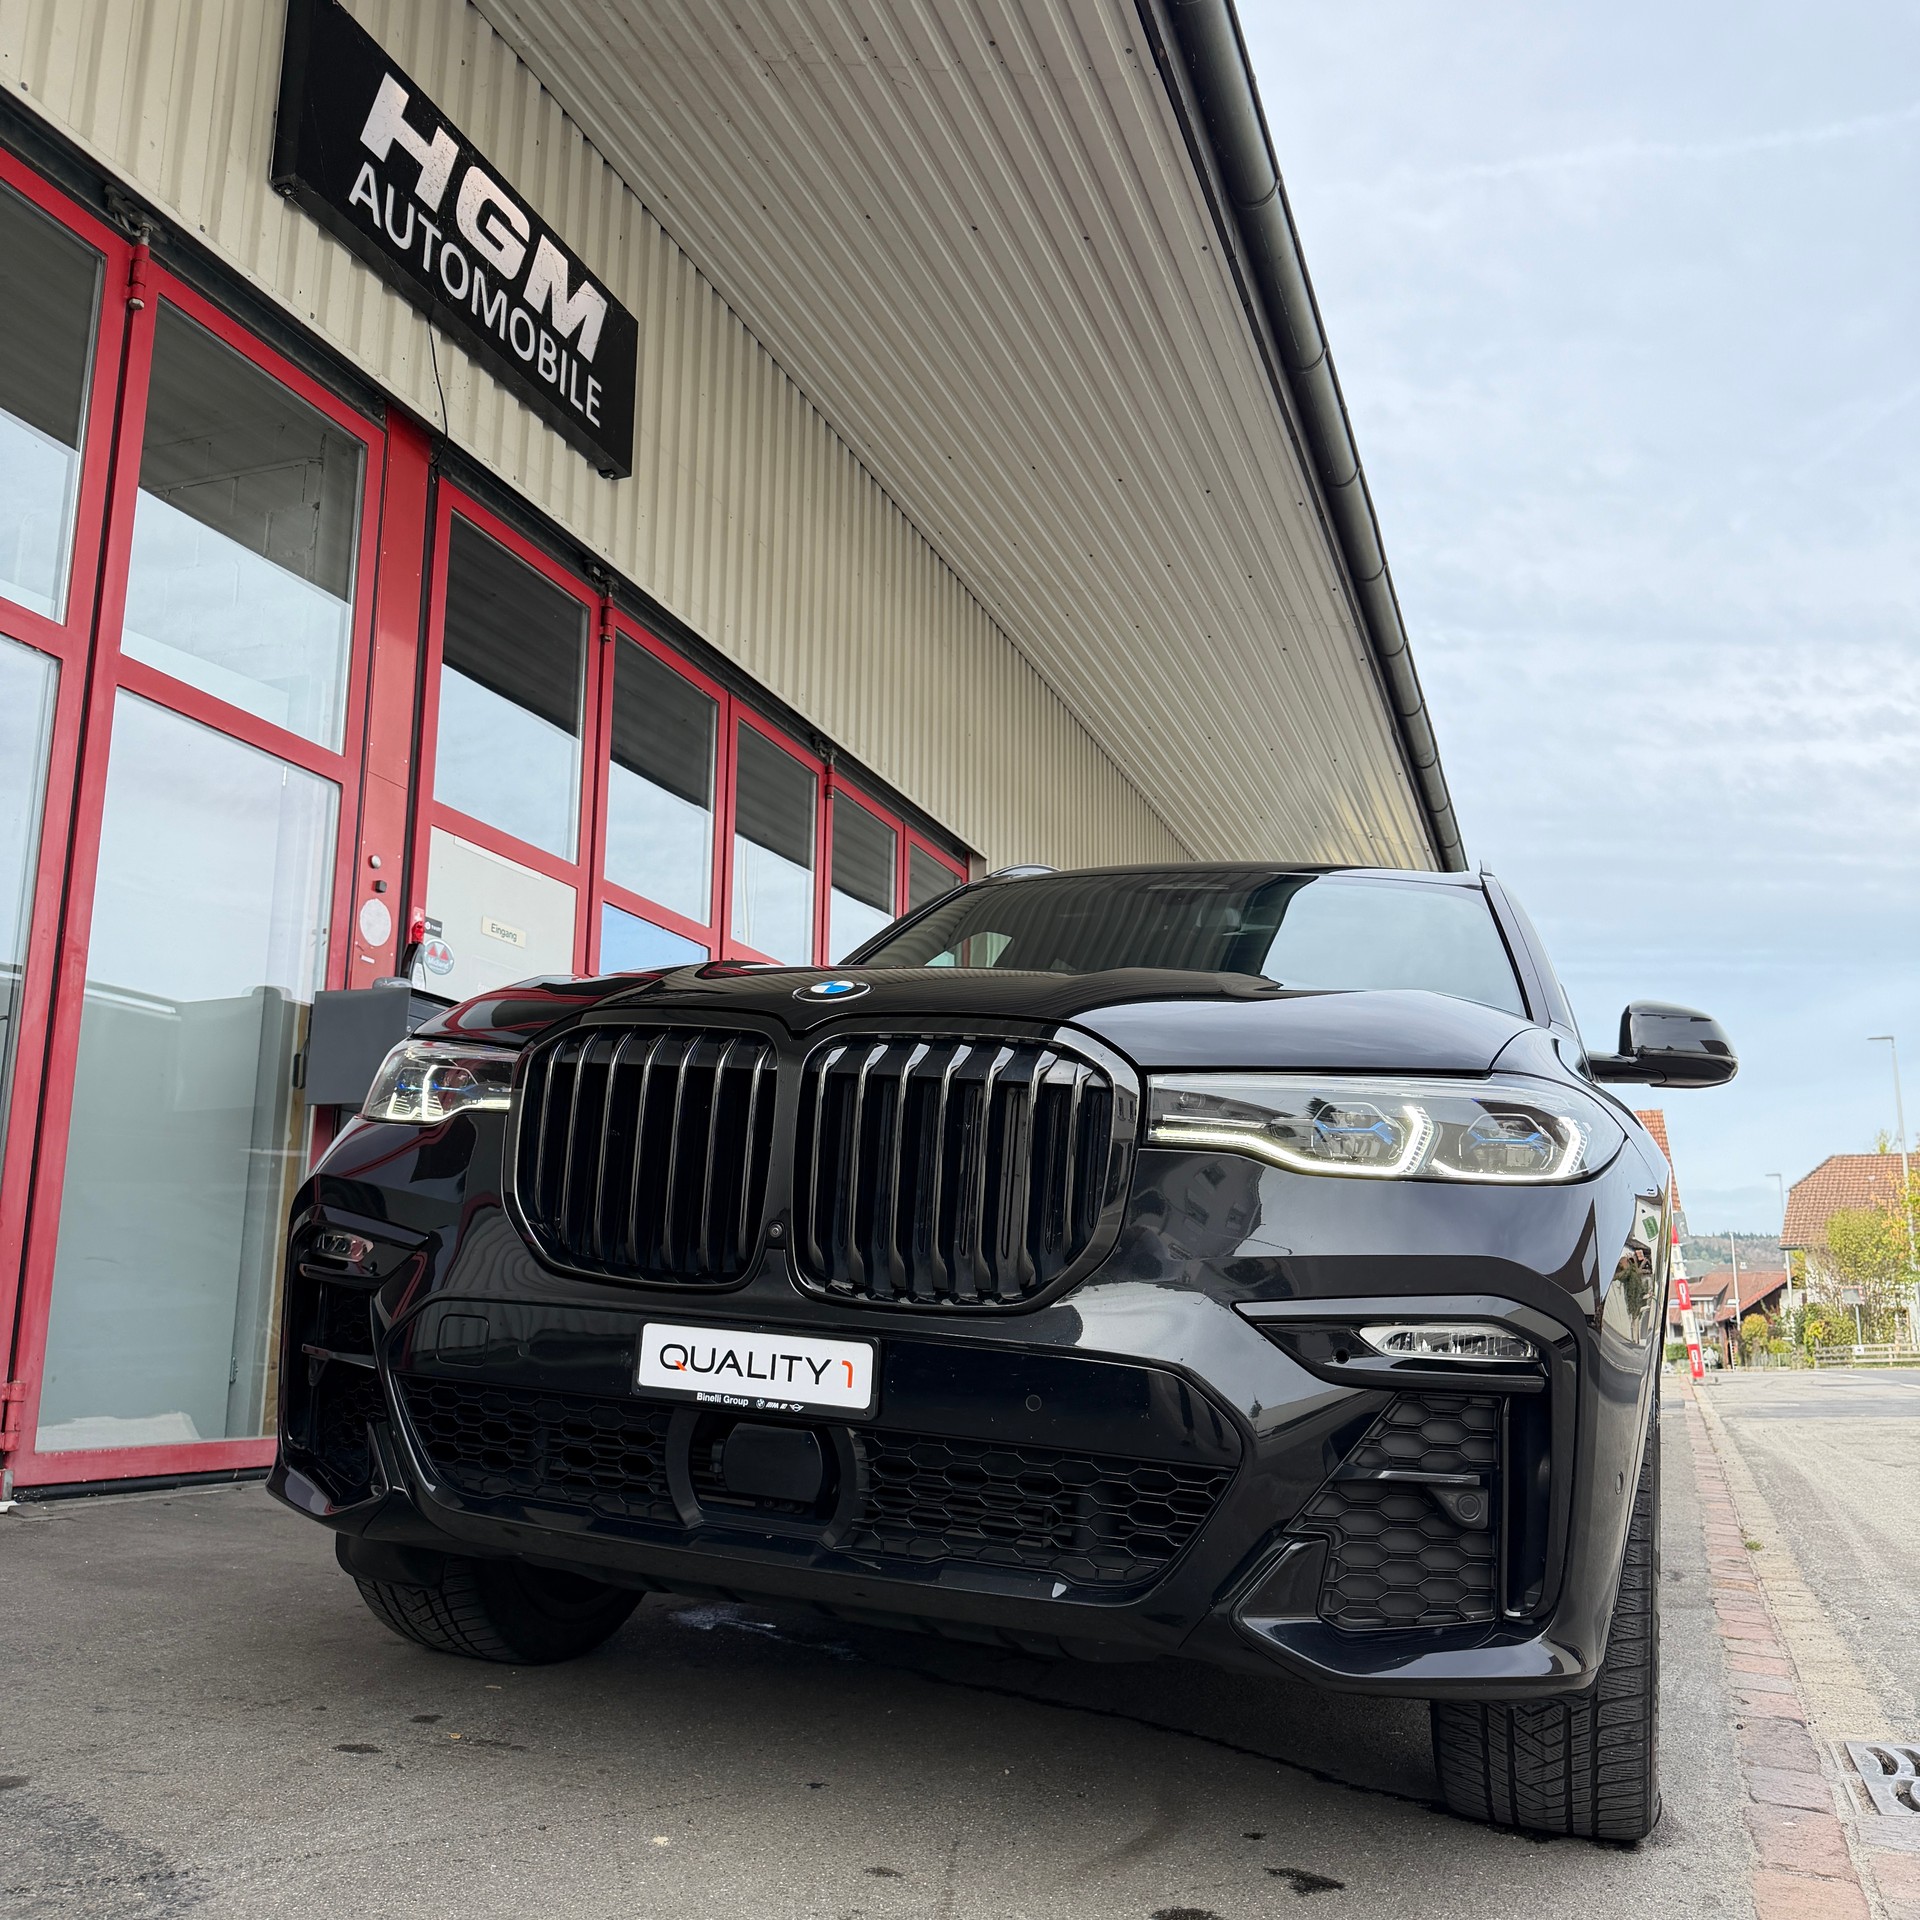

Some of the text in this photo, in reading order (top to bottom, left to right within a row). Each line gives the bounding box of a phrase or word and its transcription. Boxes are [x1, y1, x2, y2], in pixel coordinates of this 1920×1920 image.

[360, 72, 608, 364] HGM
[348, 161, 602, 428] AUTOMOBILE
[490, 922, 518, 943] Eingang
[696, 1392, 749, 1407] Binelli Group
